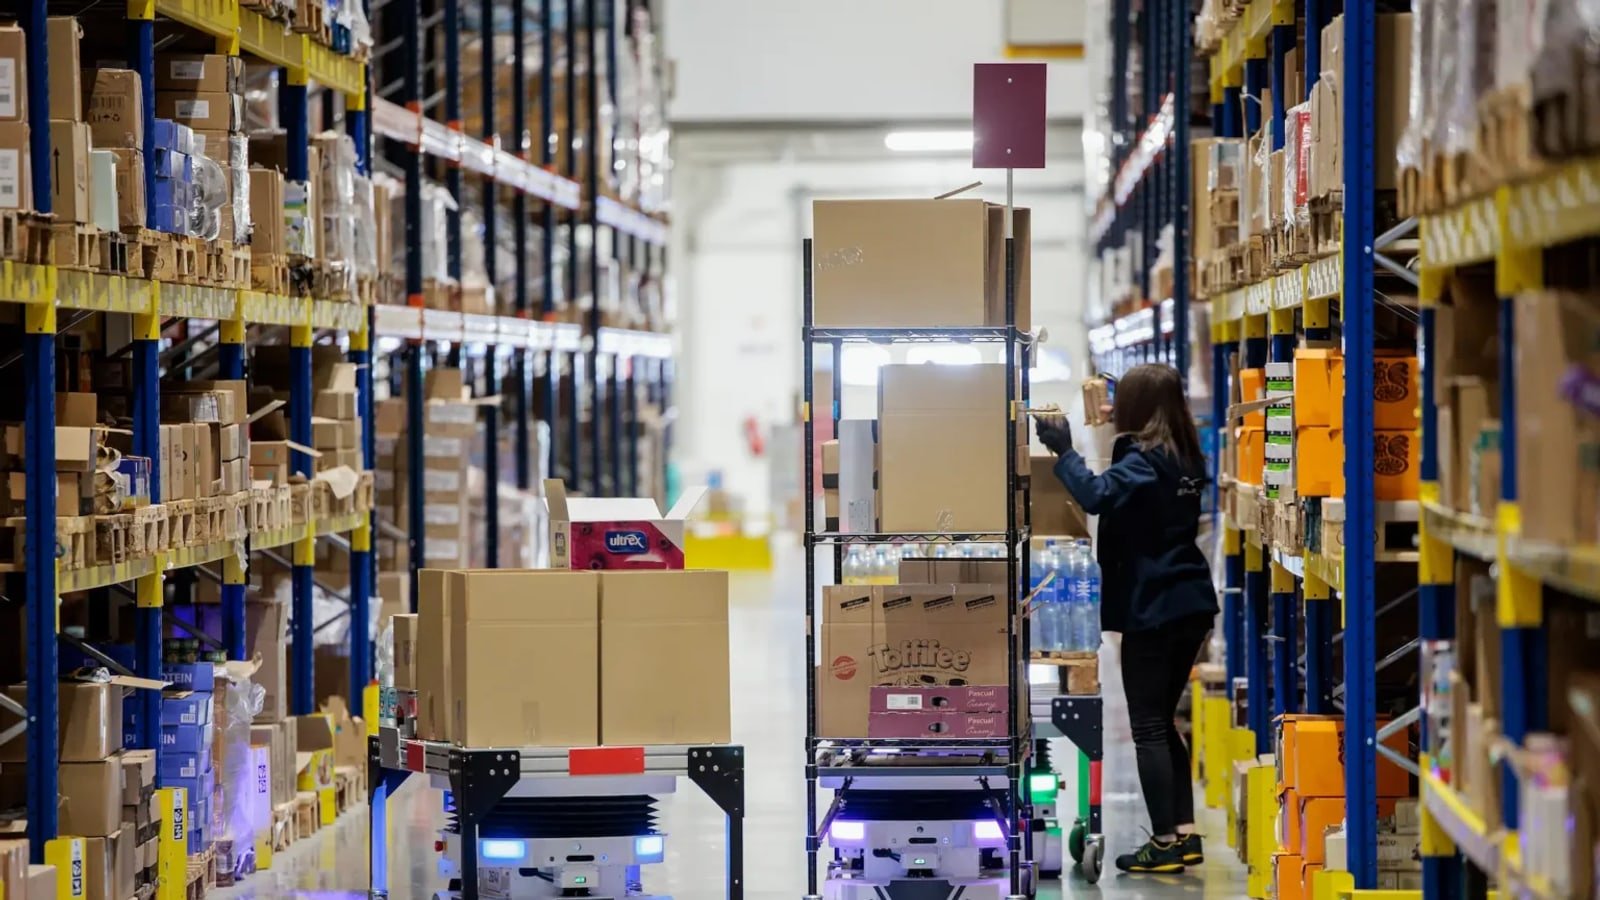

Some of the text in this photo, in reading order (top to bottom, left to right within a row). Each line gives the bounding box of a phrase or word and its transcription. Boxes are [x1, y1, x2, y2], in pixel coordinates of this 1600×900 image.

[609, 534, 645, 548] ultrex
[867, 639, 970, 672] Toffifee
[161, 673, 192, 683] OTEIN
